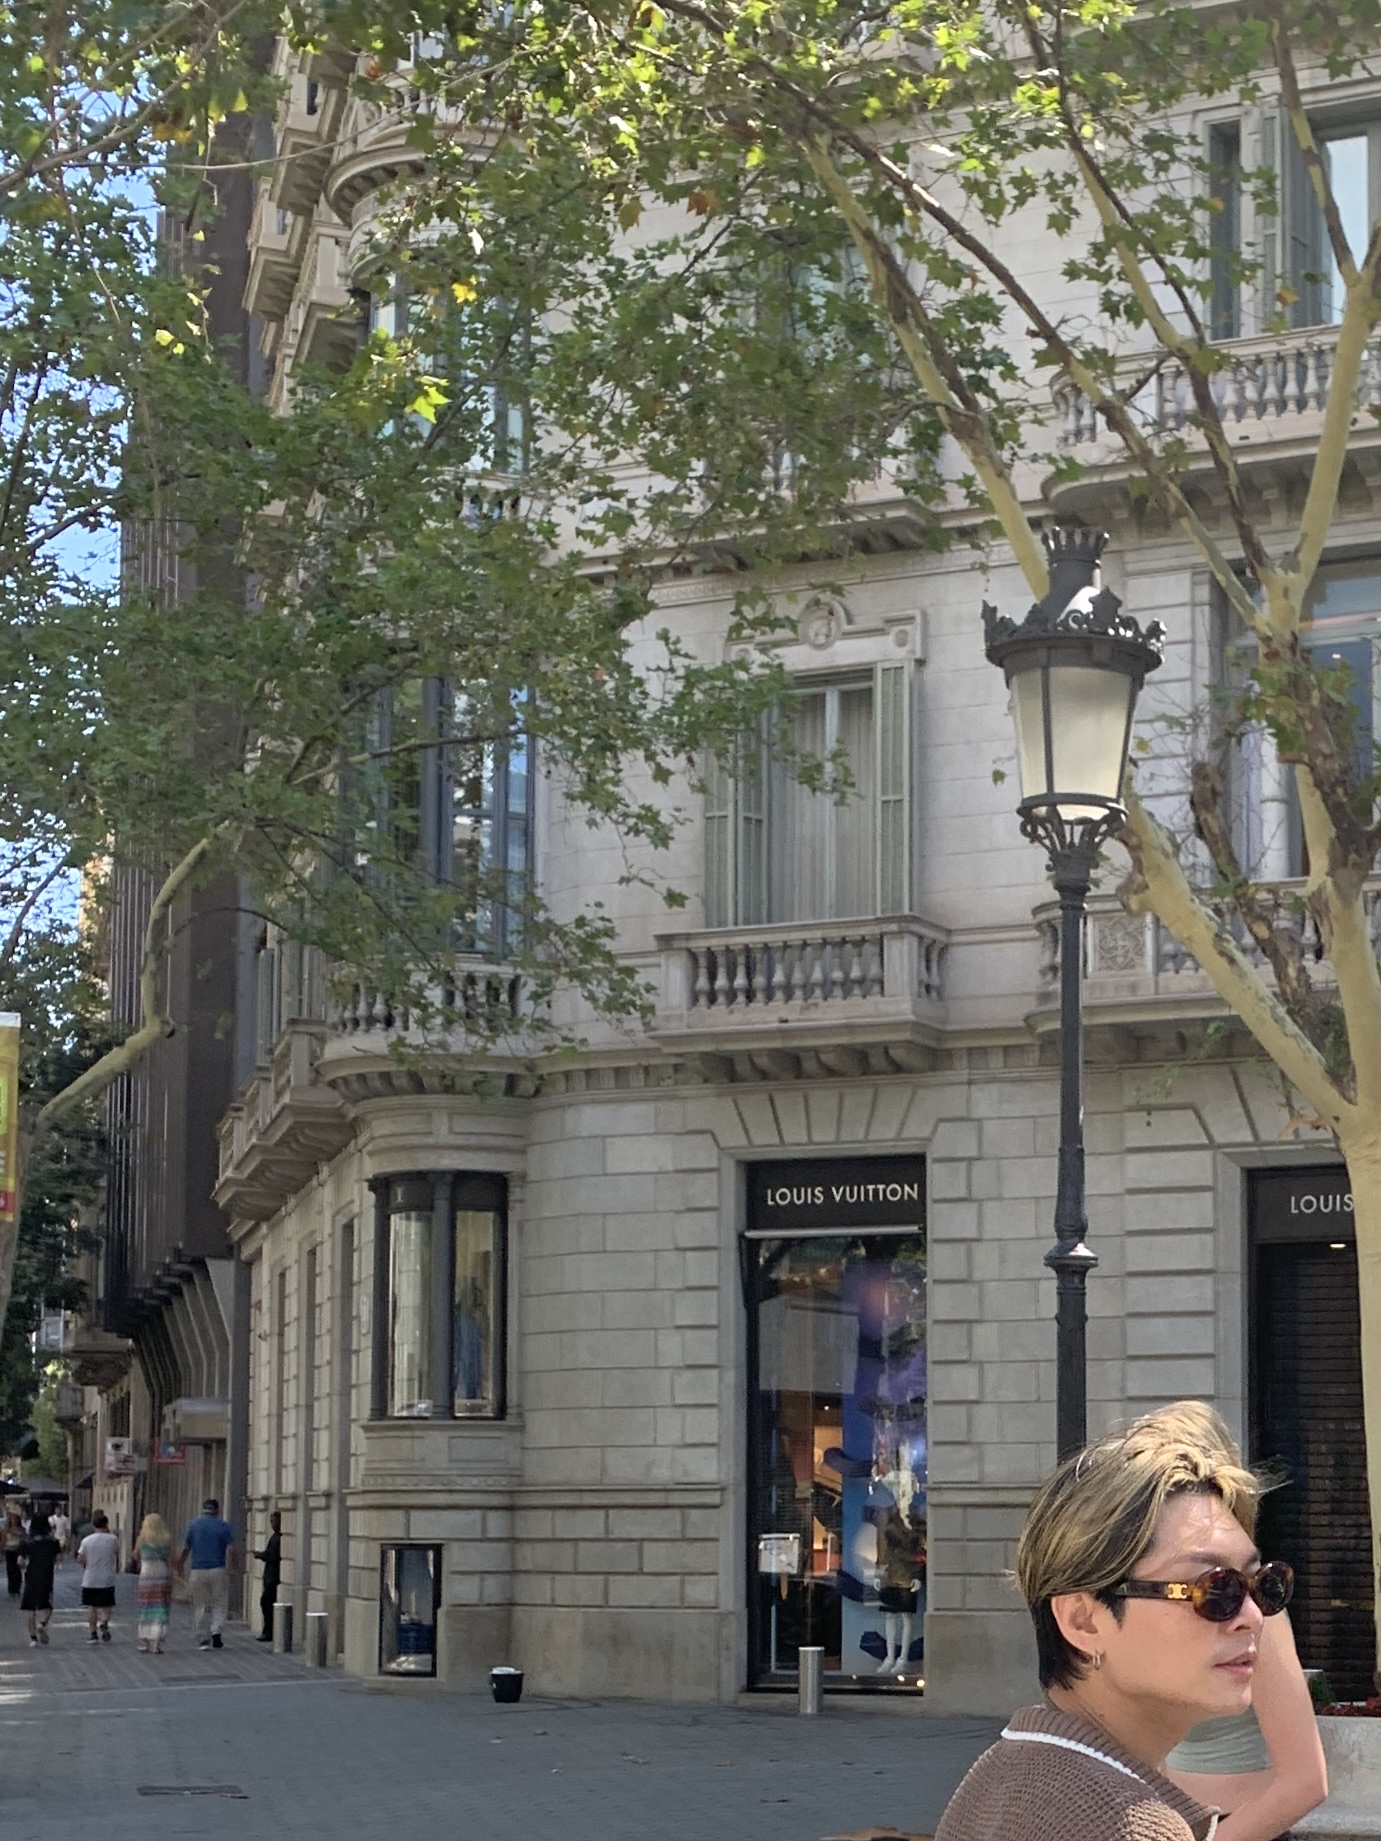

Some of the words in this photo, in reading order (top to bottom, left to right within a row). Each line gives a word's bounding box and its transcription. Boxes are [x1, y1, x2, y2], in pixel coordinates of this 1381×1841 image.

[767, 1186, 824, 1206] LOUIS
[831, 1183, 919, 1203] VUITTON
[1290, 1193, 1354, 1214] LOUIS
